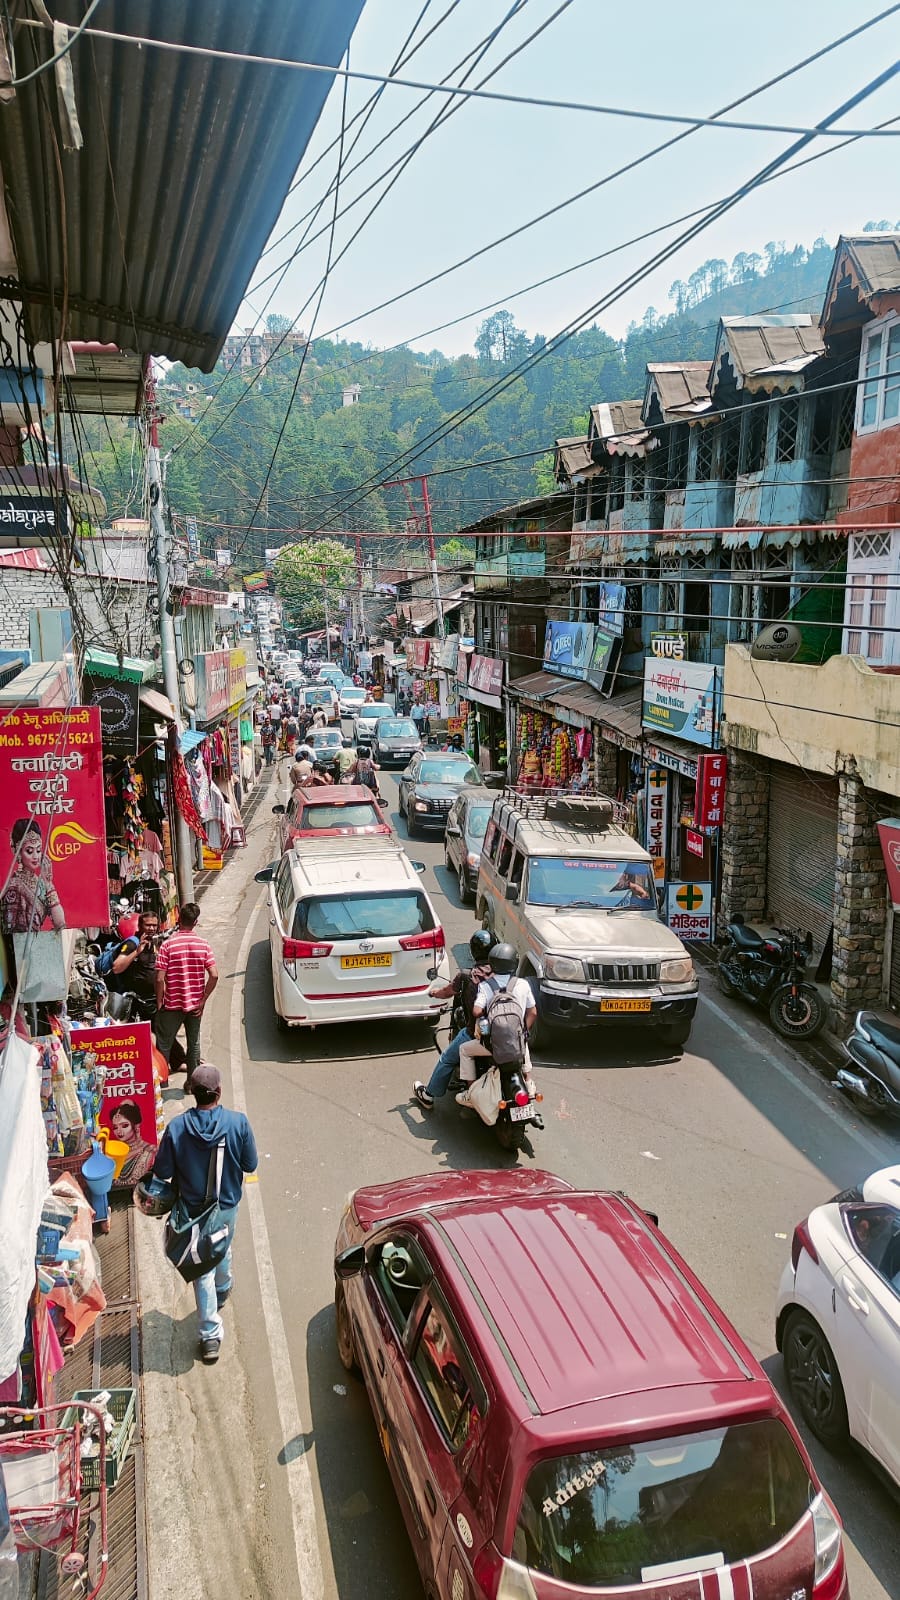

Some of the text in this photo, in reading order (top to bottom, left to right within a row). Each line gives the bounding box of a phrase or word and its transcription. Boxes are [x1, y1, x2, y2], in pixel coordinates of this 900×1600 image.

[0, 502, 55, 530] alayas
[27, 732, 95, 747] 9675215621
[11, 752, 84, 773] क्वालिटी
[29, 774, 69, 798] ब्यूटी
[26, 795, 75, 815] पार्लर
[56, 842, 81, 855] KBP
[670, 914, 710, 929] मेडिकल
[95, 1050, 140, 1062] 75215621
[542, 1461, 607, 1517] Aditya
